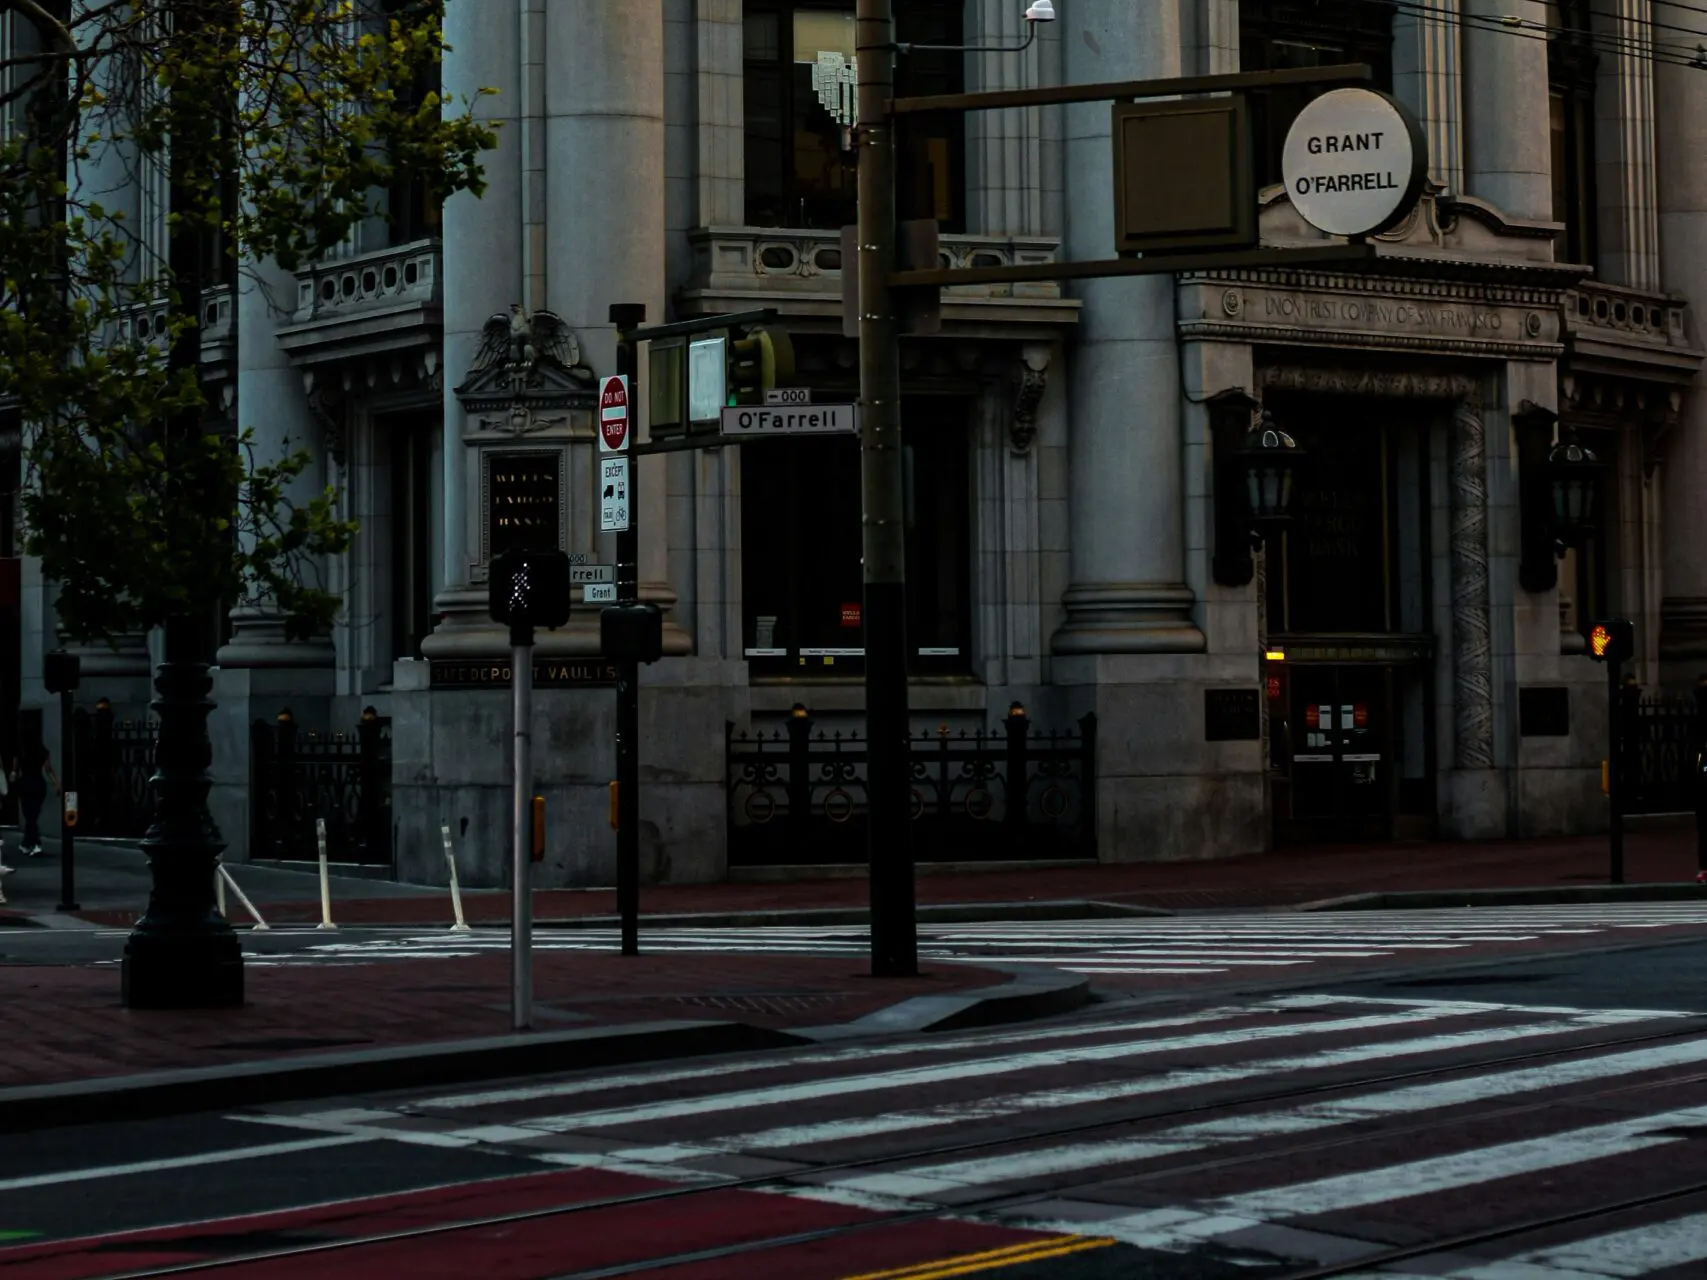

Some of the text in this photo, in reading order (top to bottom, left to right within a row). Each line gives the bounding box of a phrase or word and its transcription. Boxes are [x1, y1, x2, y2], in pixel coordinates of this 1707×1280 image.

[1307, 132, 1384, 155] GRANT
[1295, 171, 1399, 195] O'FARRELL
[604, 390, 625, 404] DO NOT
[781, 390, 806, 402] 000
[738, 410, 836, 429] O'Farrell
[606, 423, 623, 436] ENTER
[605, 465, 624, 478] EXCEPT
[591, 587, 611, 598] Grant
[469, 666, 540, 682] DEPOT
